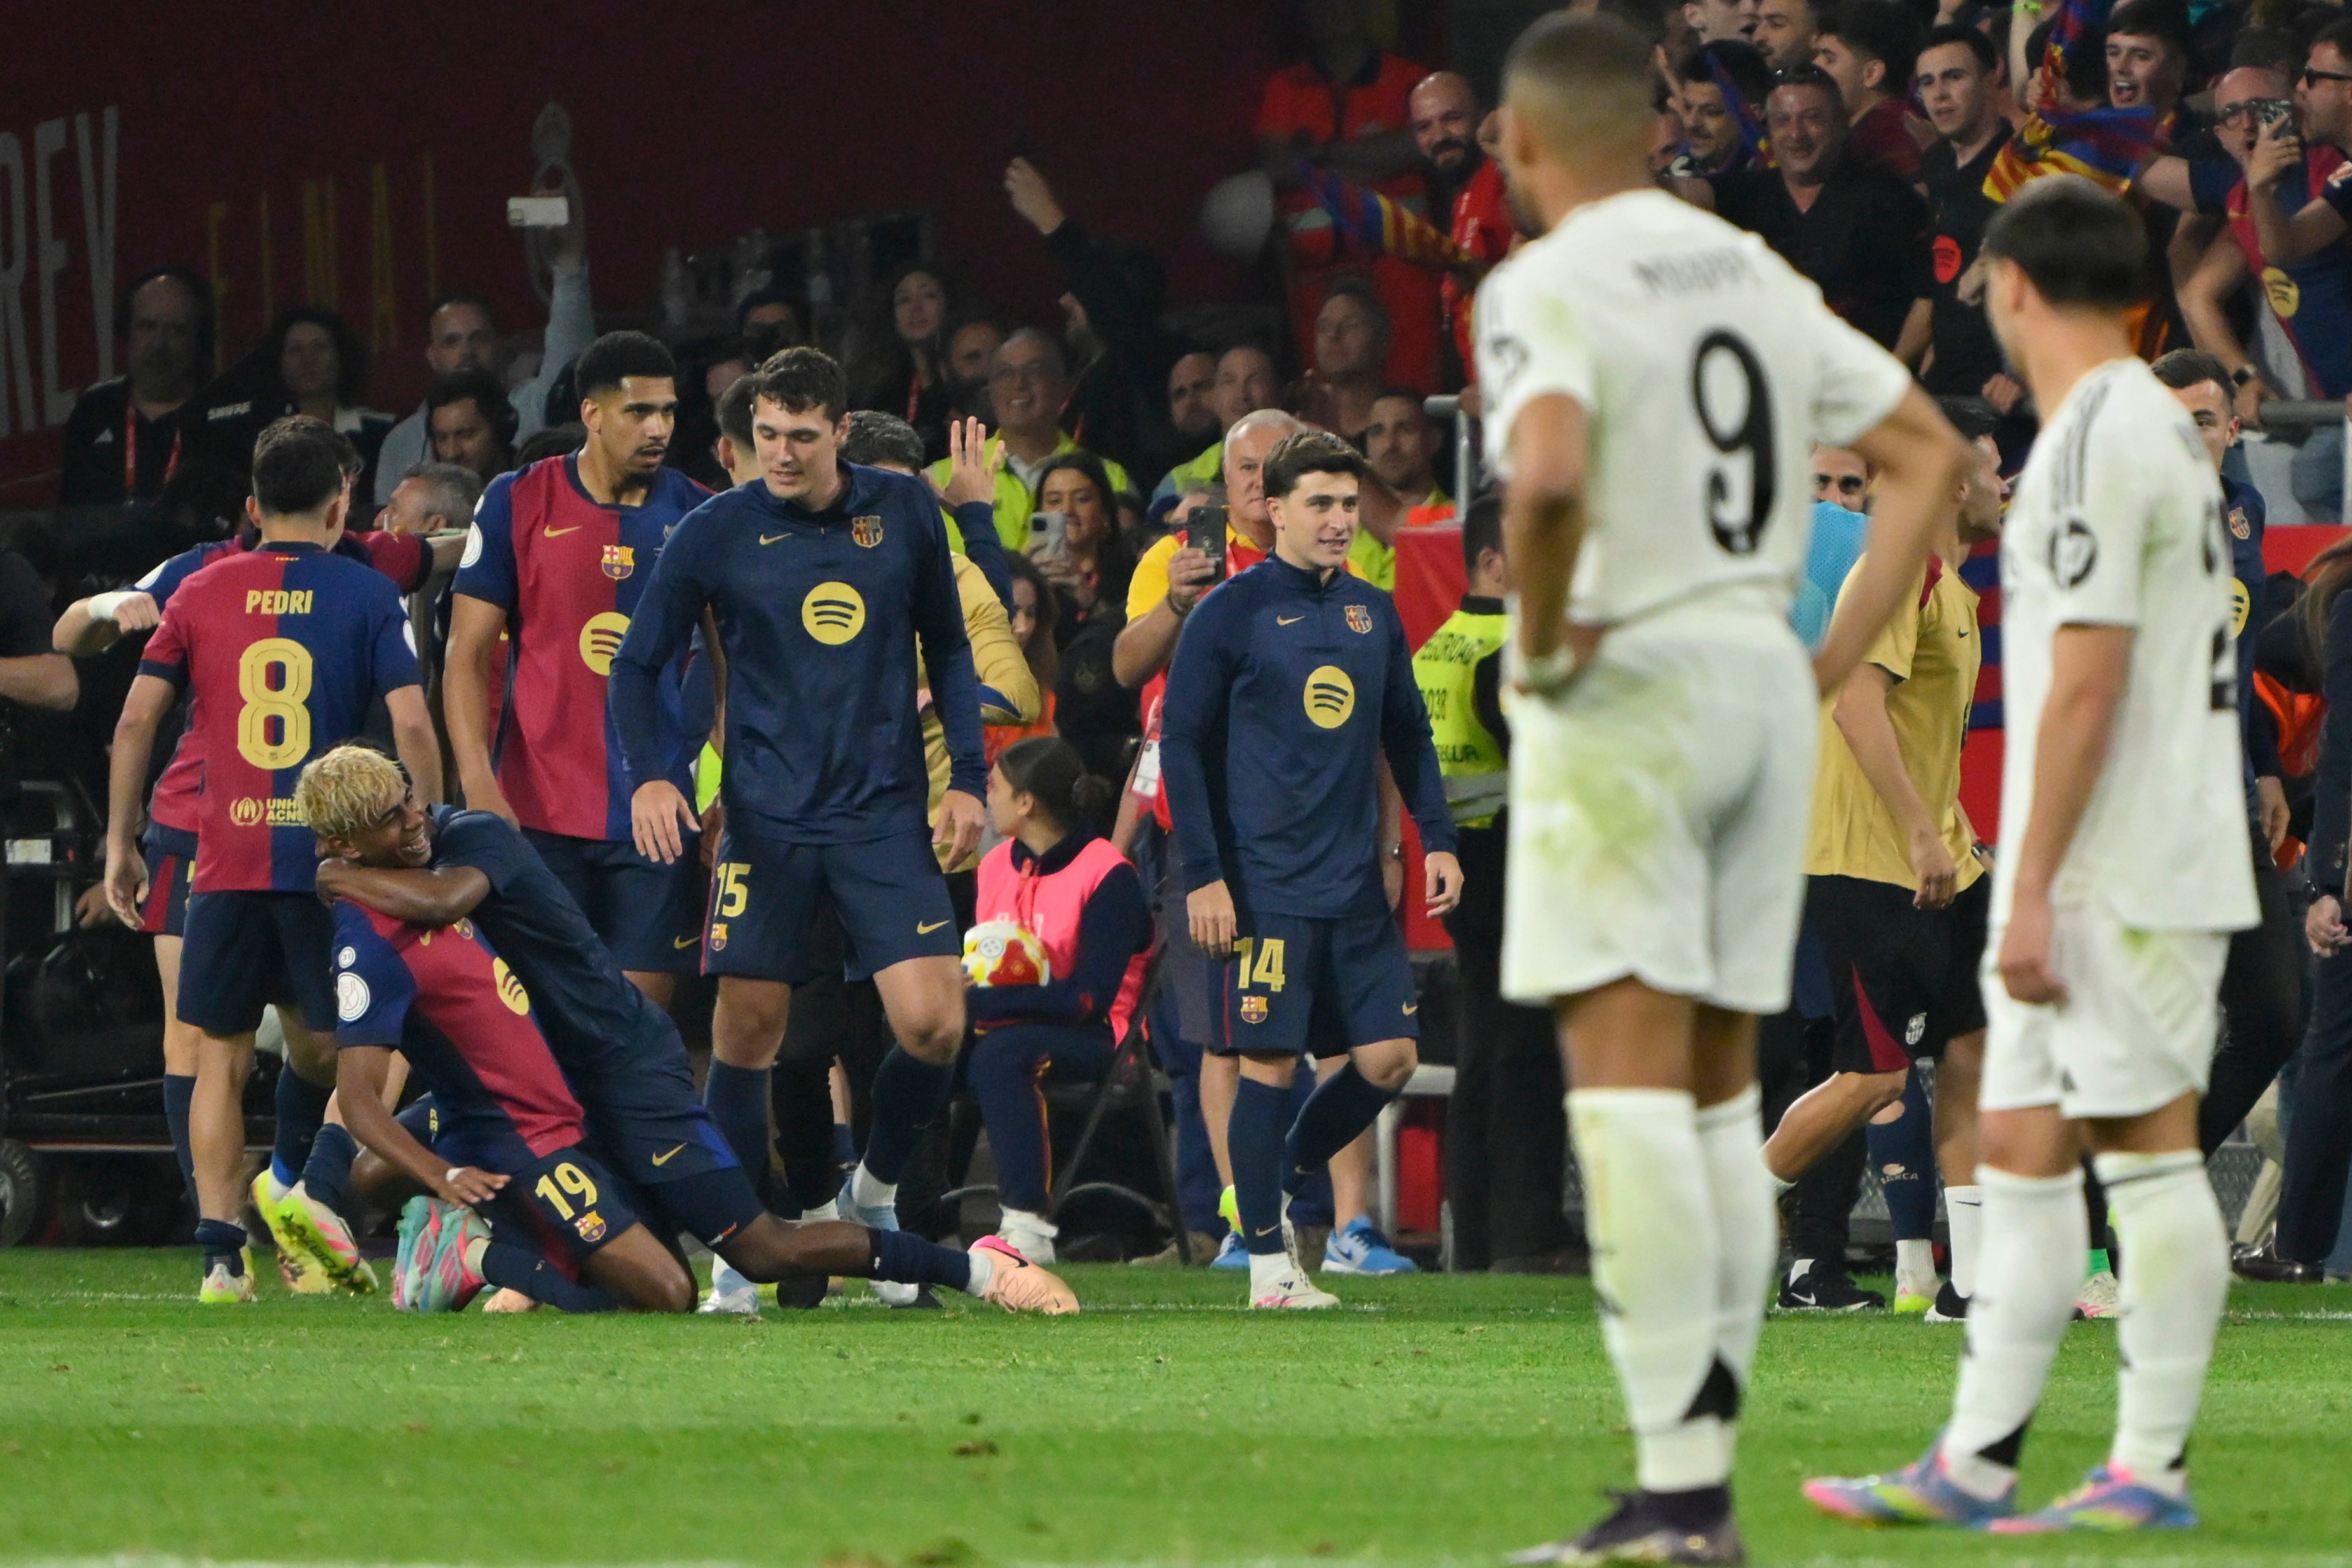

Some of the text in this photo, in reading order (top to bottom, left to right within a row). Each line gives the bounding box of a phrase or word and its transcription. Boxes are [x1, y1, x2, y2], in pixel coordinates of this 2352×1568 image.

[1691, 323, 1777, 554] 9
[245, 589, 313, 615] PEDRI
[237, 637, 312, 770] 8
[266, 798, 297, 810] UNH
[266, 810, 301, 821] ACN
[714, 862, 752, 917] 15
[1233, 937, 1285, 992] 14
[535, 1162, 598, 1221] 19
